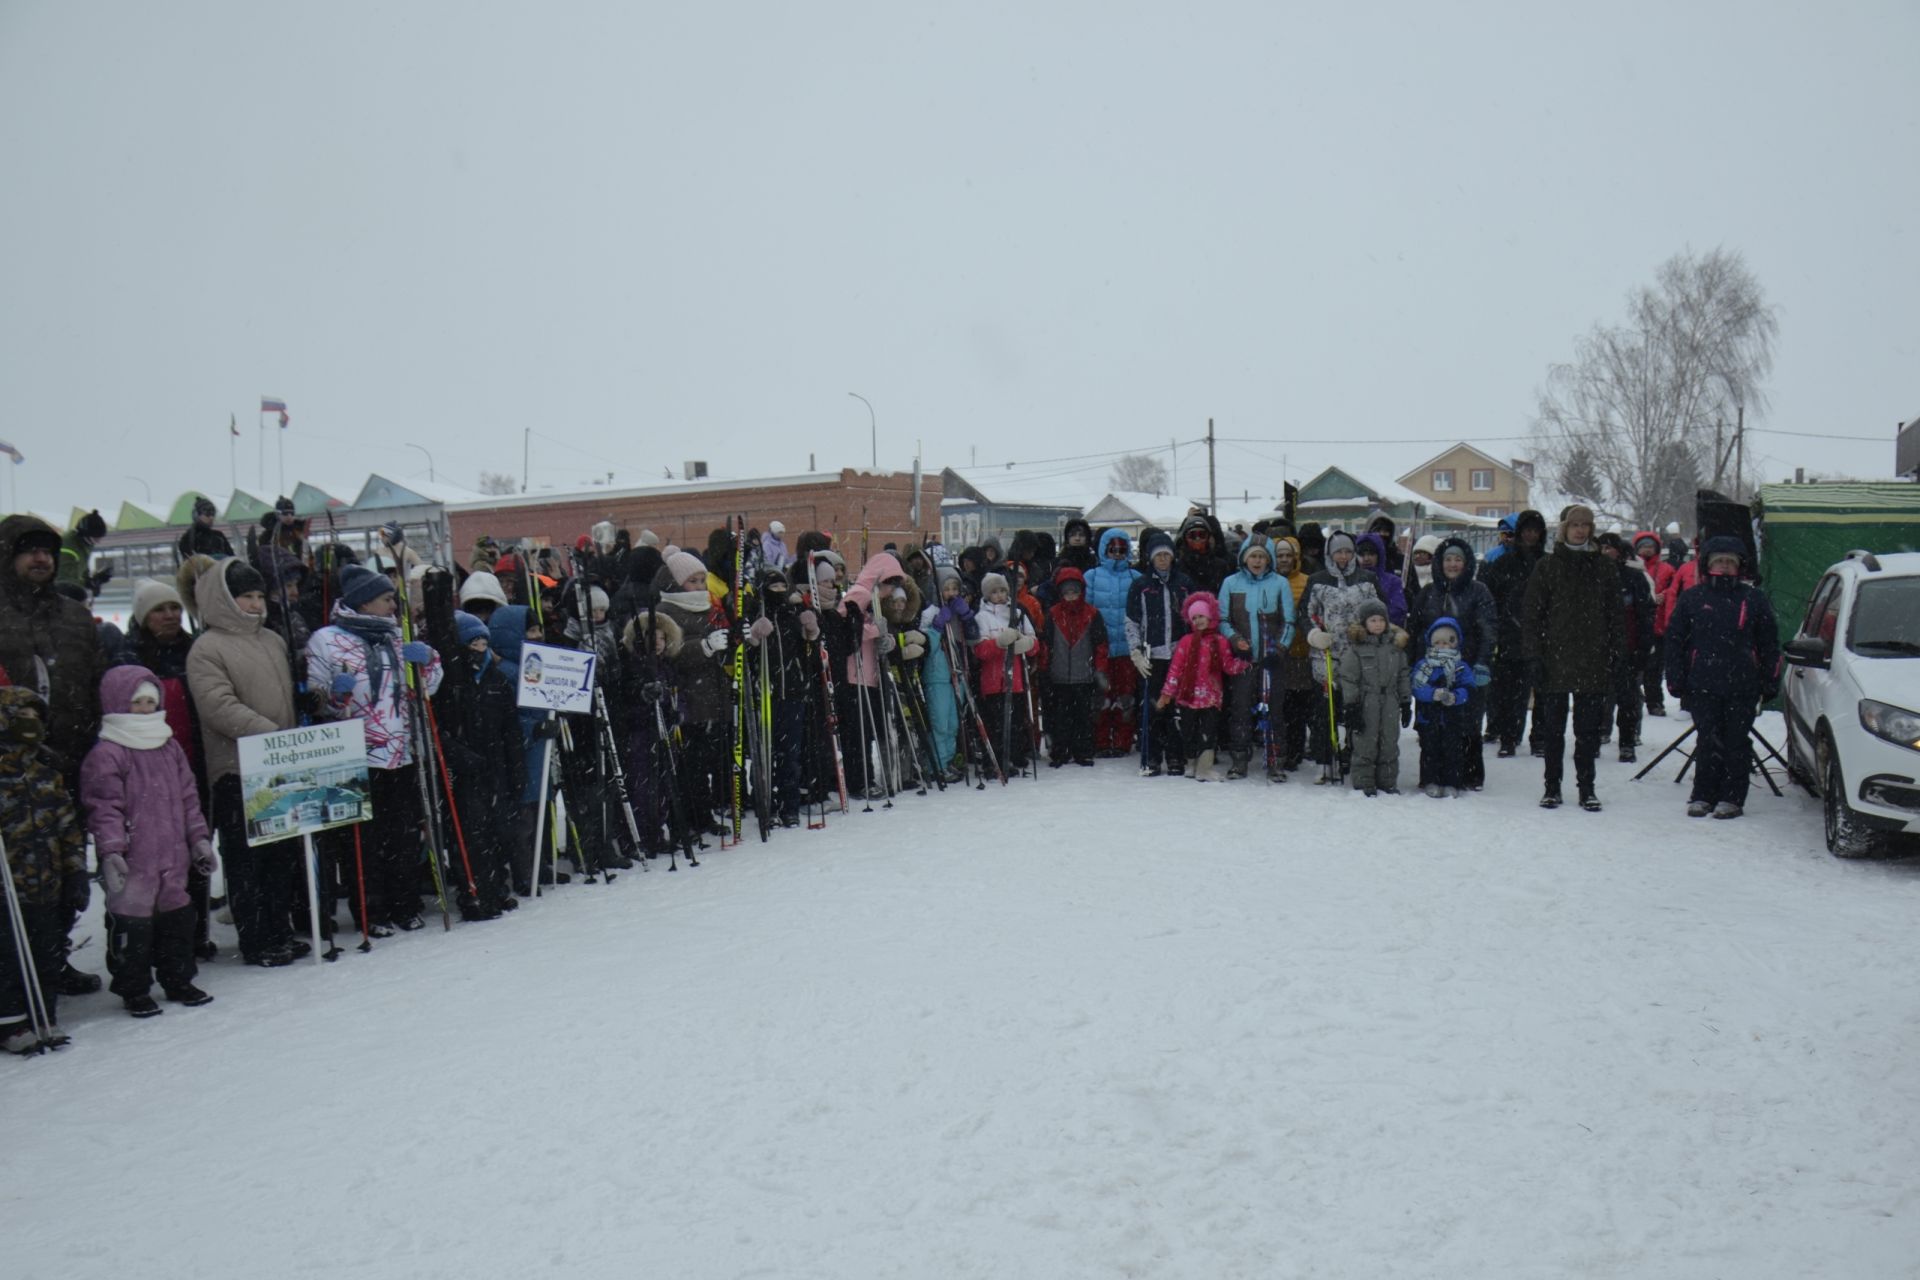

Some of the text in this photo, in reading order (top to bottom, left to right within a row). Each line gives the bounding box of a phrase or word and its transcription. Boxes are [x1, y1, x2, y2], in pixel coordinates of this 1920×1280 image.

[578, 656, 594, 692] 1
[264, 727, 341, 751] МБДОУ №1
[263, 745, 345, 766] «Нефтяник»
